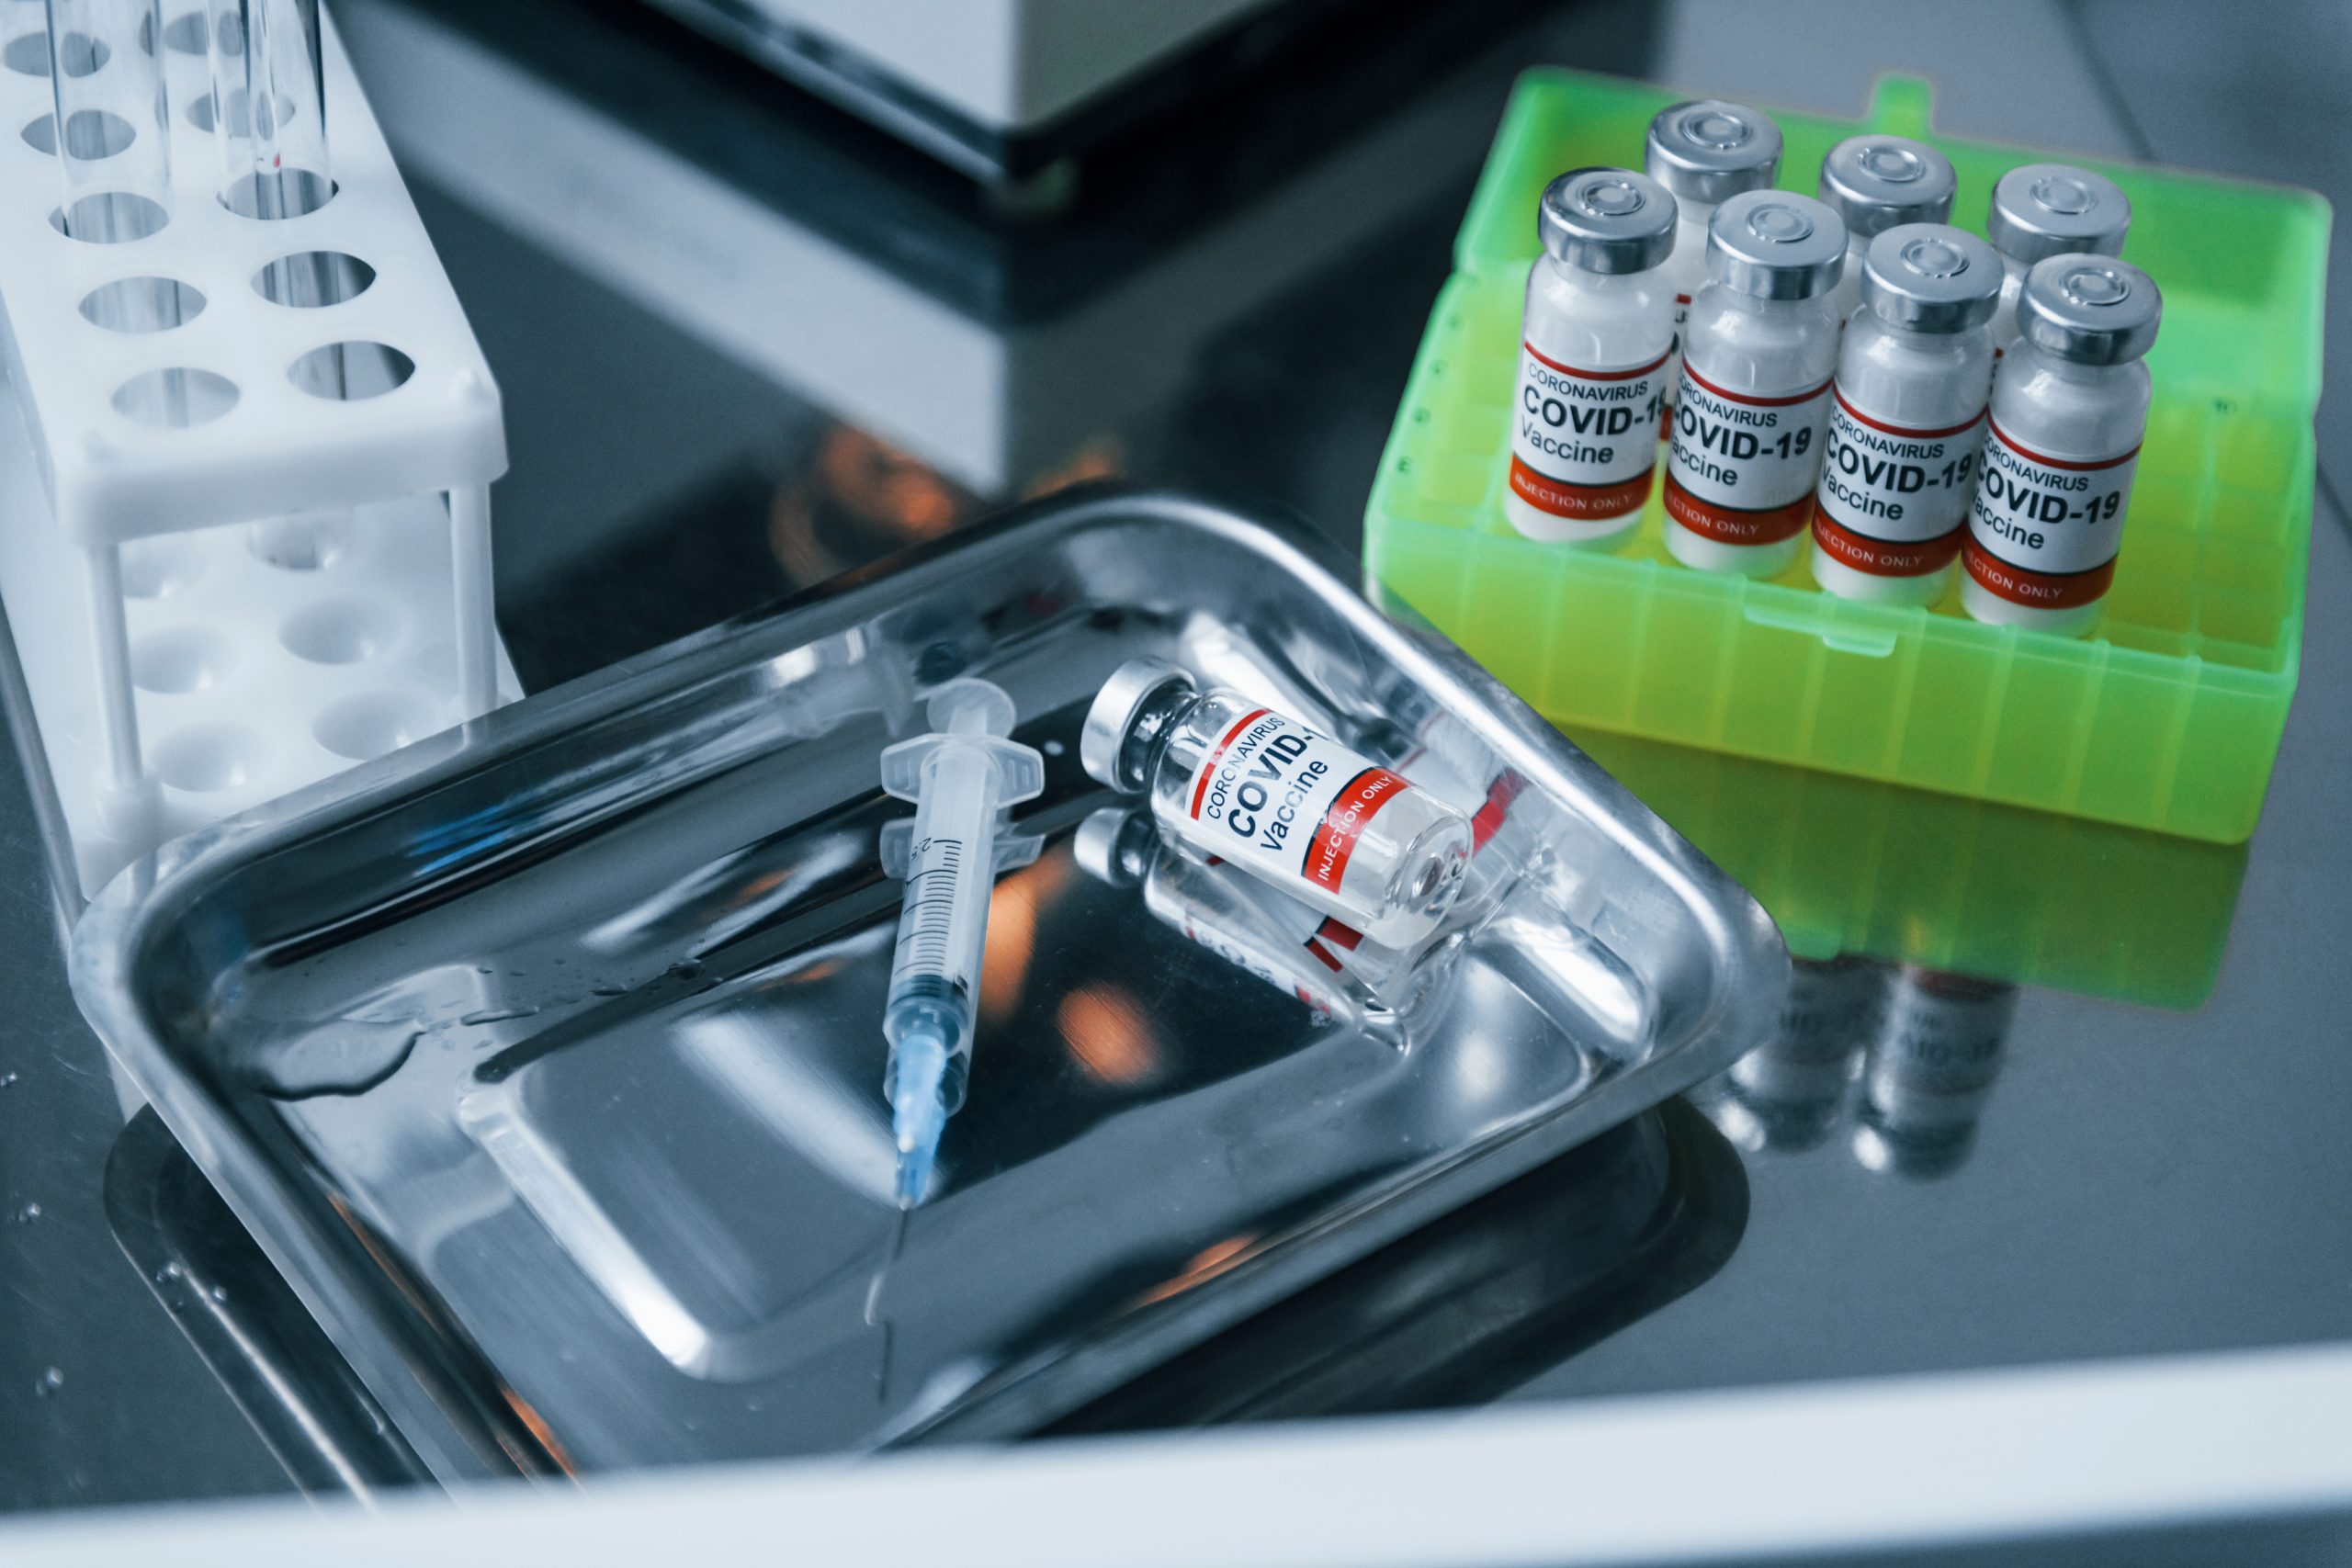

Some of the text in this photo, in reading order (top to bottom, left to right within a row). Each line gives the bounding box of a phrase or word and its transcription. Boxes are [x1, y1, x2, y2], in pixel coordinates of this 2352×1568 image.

[1529, 362, 1648, 401] CORONAVIRUS
[1679, 374, 1778, 428] ORONAVIRUS
[1521, 413, 1614, 464] Vaccine
[1672, 426, 1738, 486] accine
[1833, 405, 1944, 458] CORONAVIRUS
[1827, 426, 1973, 493] COVID-19
[1593, 492, 1634, 511] ONLY
[1716, 519, 1759, 536] ONLY
[1881, 555, 1924, 568] ONLY
[2018, 583, 2064, 599] ONLY
[1206, 717, 1285, 819] CORONAVIRUS
[1261, 760, 1329, 852] Vaccine
[1317, 775, 1394, 882] INJECTION ONLY
